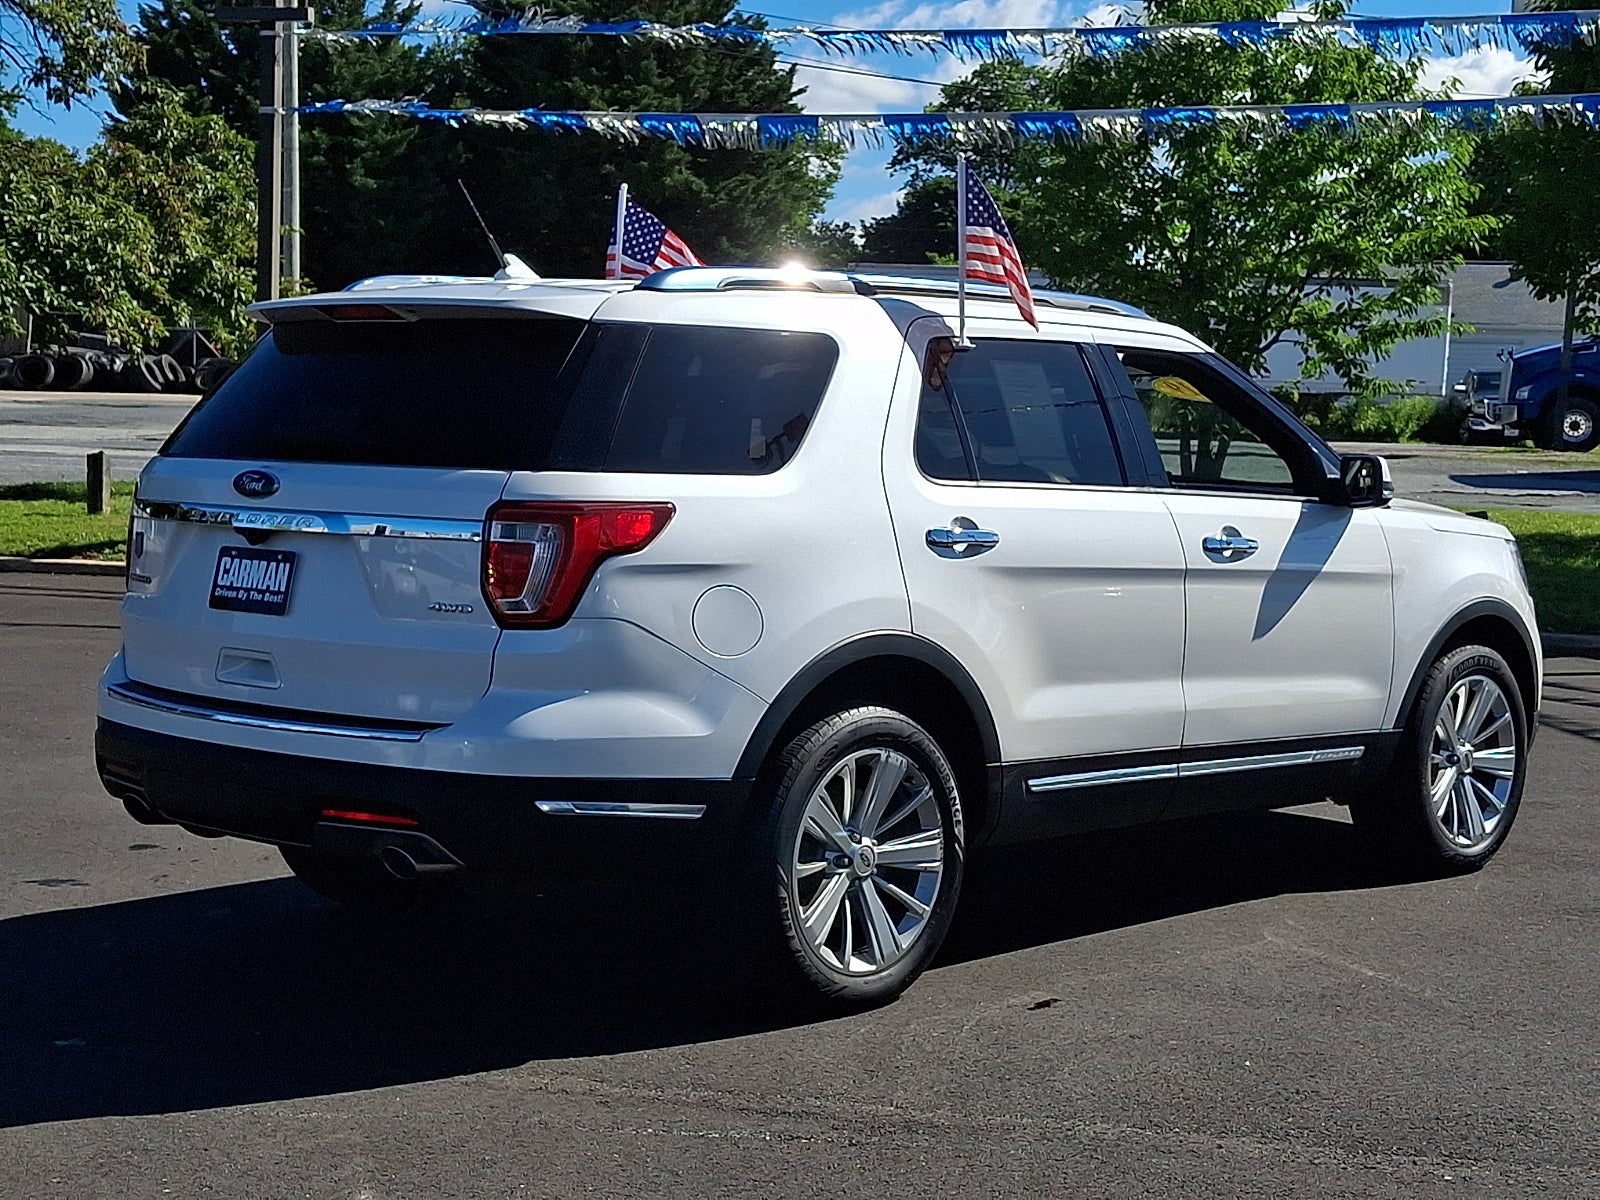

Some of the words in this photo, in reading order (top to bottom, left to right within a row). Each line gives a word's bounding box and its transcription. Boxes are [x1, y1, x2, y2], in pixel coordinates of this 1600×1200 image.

[189, 507, 316, 528] EXPLORER
[217, 556, 291, 592] CARMAN
[214, 587, 237, 598] Driven
[238, 589, 248, 601] By
[249, 590, 263, 601] The
[264, 592, 284, 603] Best!
